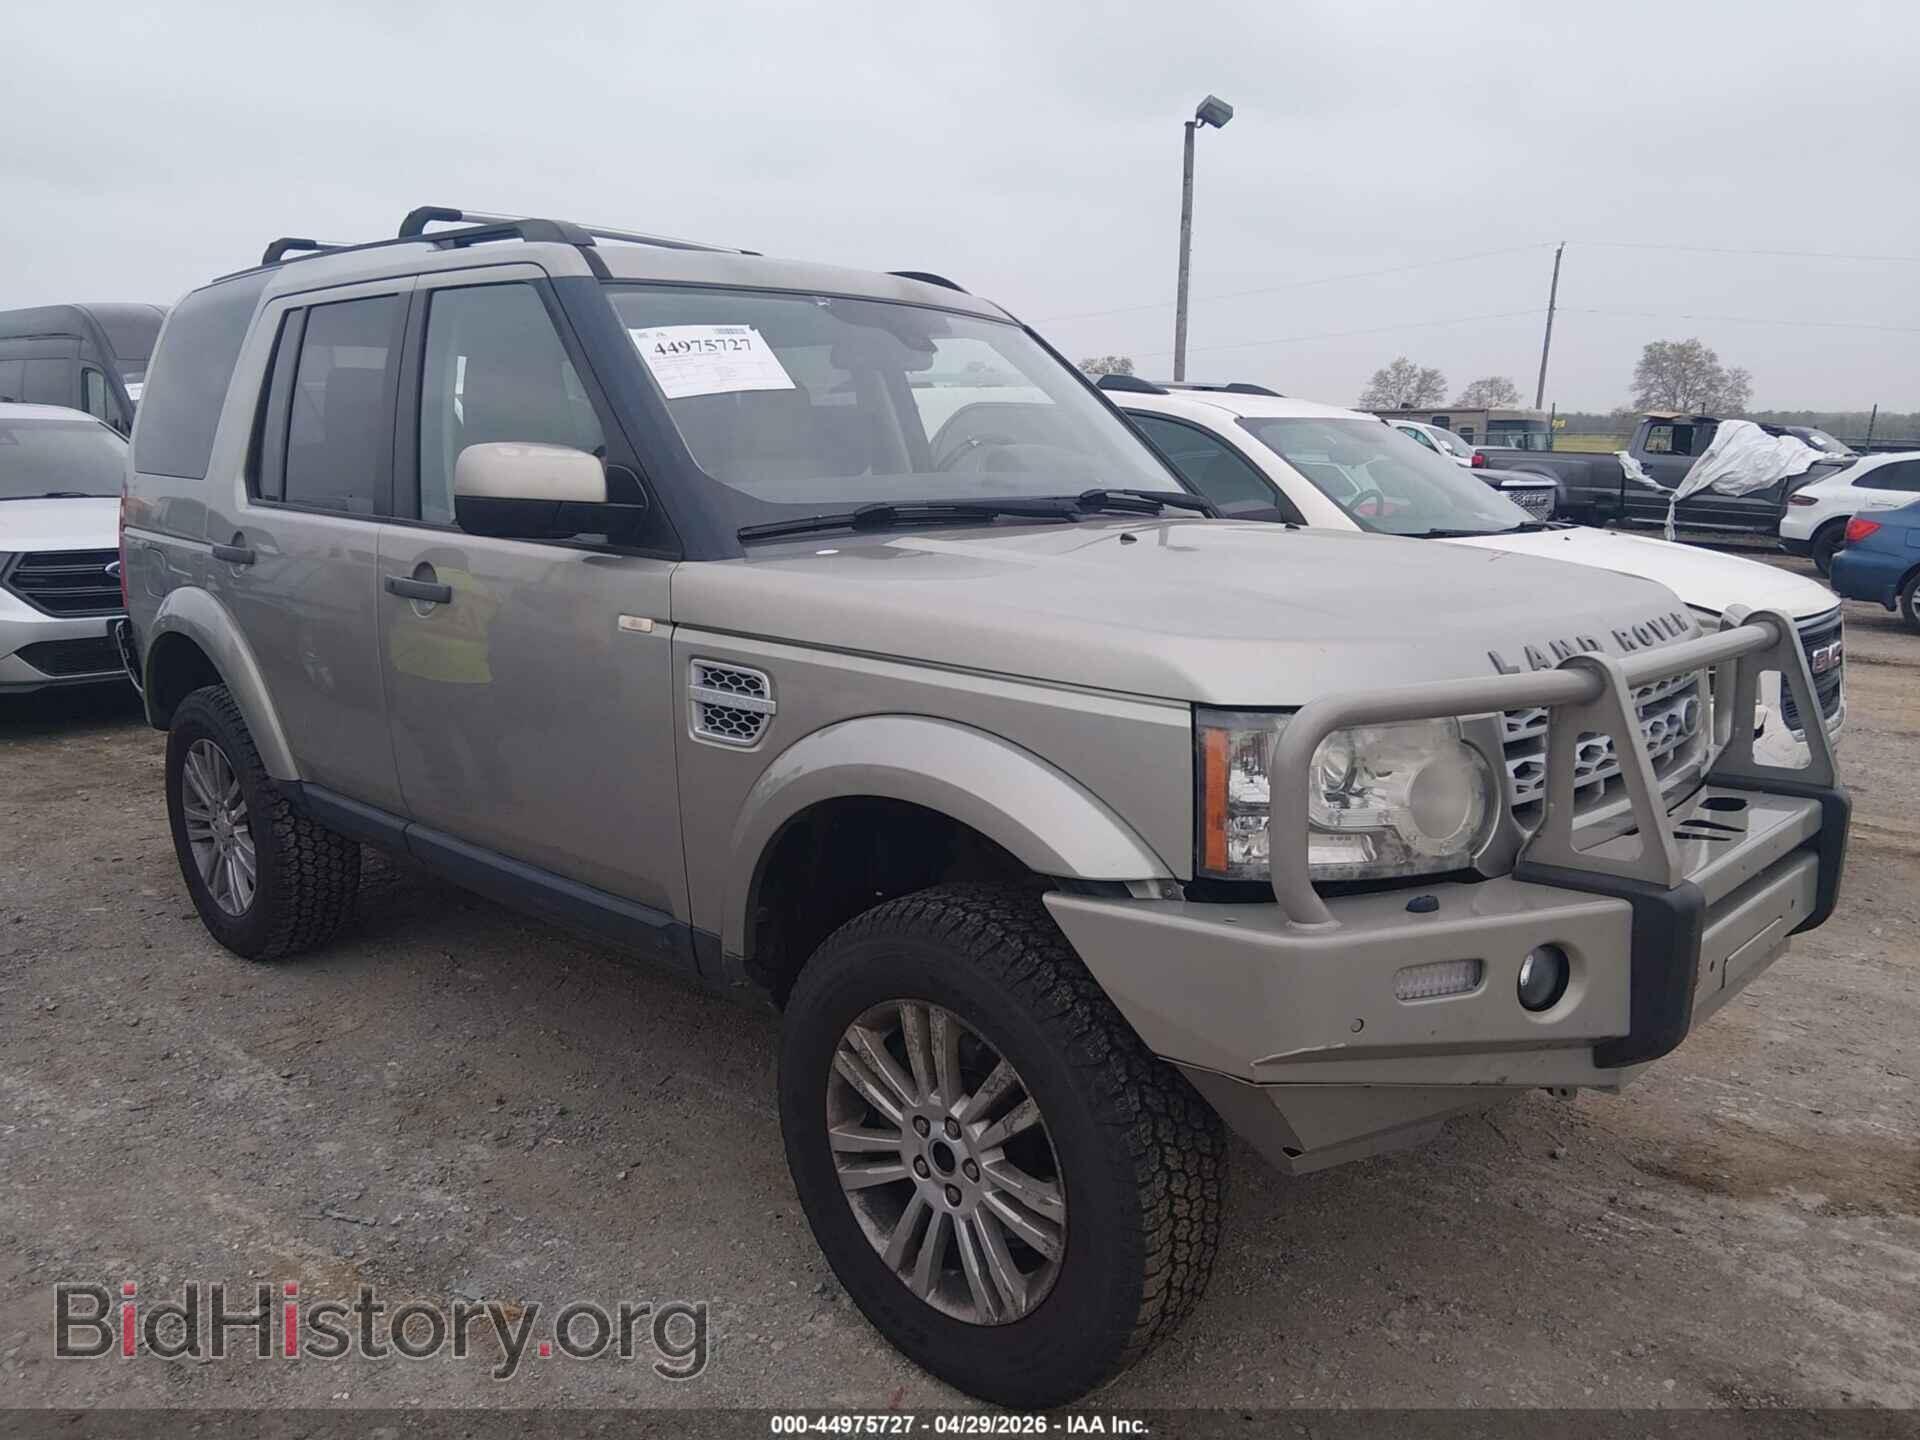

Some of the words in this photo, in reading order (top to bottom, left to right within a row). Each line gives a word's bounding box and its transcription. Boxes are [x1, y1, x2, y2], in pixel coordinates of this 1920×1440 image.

[654, 337, 751, 355] 44975727
[1487, 634, 1604, 674] LAND
[1611, 611, 1690, 652] ROVER
